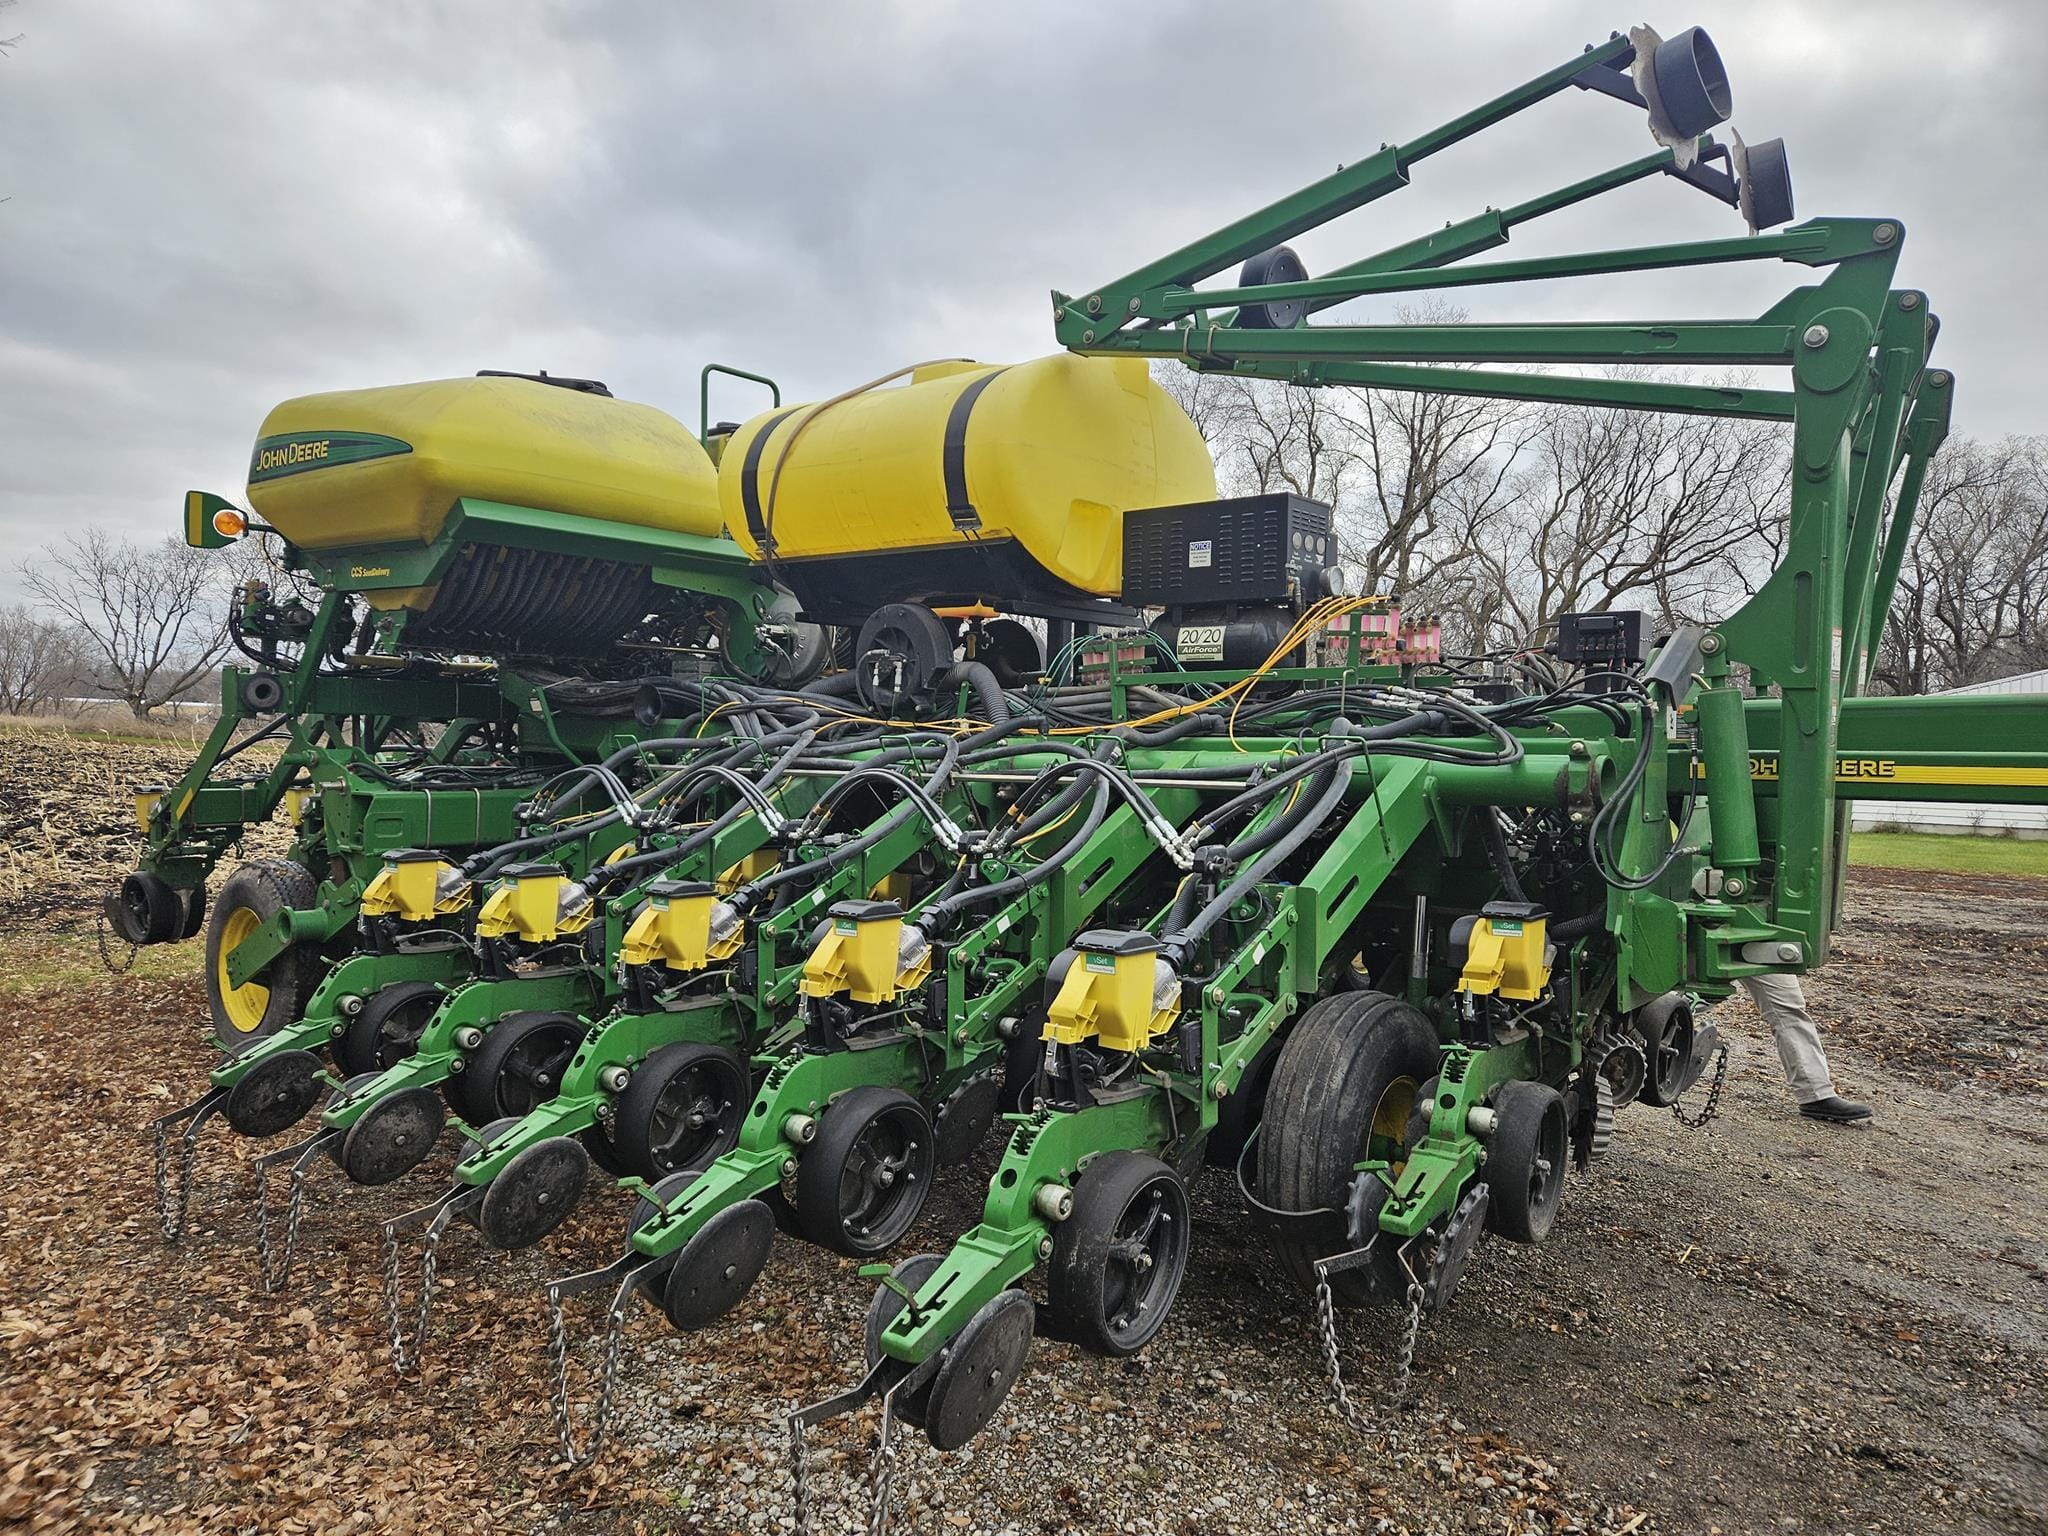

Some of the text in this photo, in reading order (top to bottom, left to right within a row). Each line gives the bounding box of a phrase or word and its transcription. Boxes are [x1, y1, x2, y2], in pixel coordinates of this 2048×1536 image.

[256, 440, 330, 471] JOHN DEERE
[1190, 542, 1211, 551] NOTICE
[1180, 629, 1222, 644] 20/20
